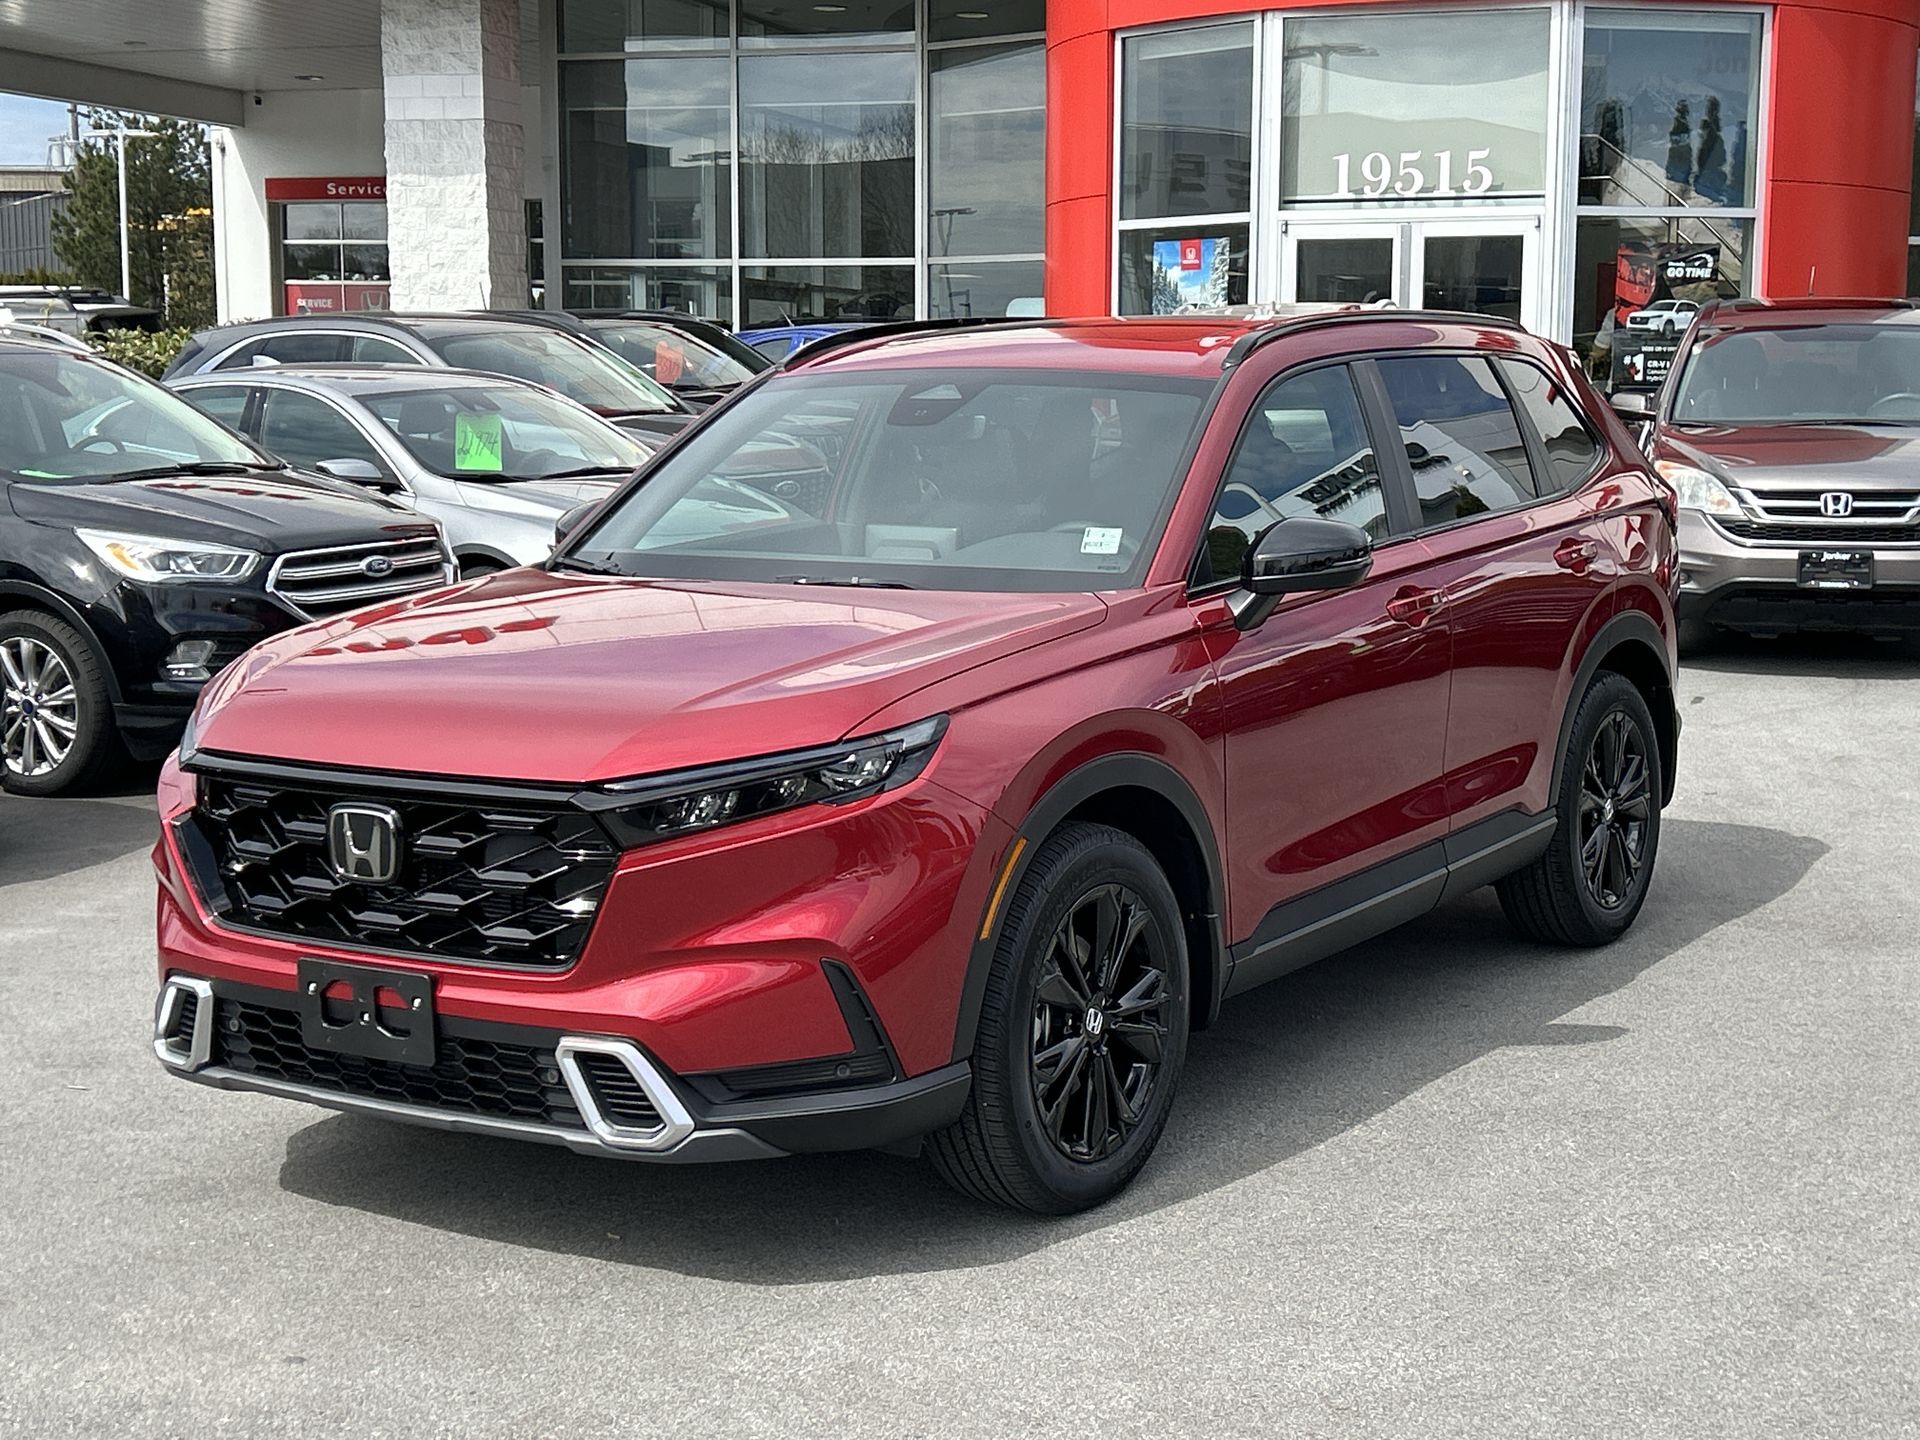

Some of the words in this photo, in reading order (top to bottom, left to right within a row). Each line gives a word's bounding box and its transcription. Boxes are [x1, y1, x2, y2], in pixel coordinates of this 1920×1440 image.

[1332, 147, 1493, 197] 19515
[1666, 267, 1684, 278] GO
[1685, 267, 1712, 278] TIME
